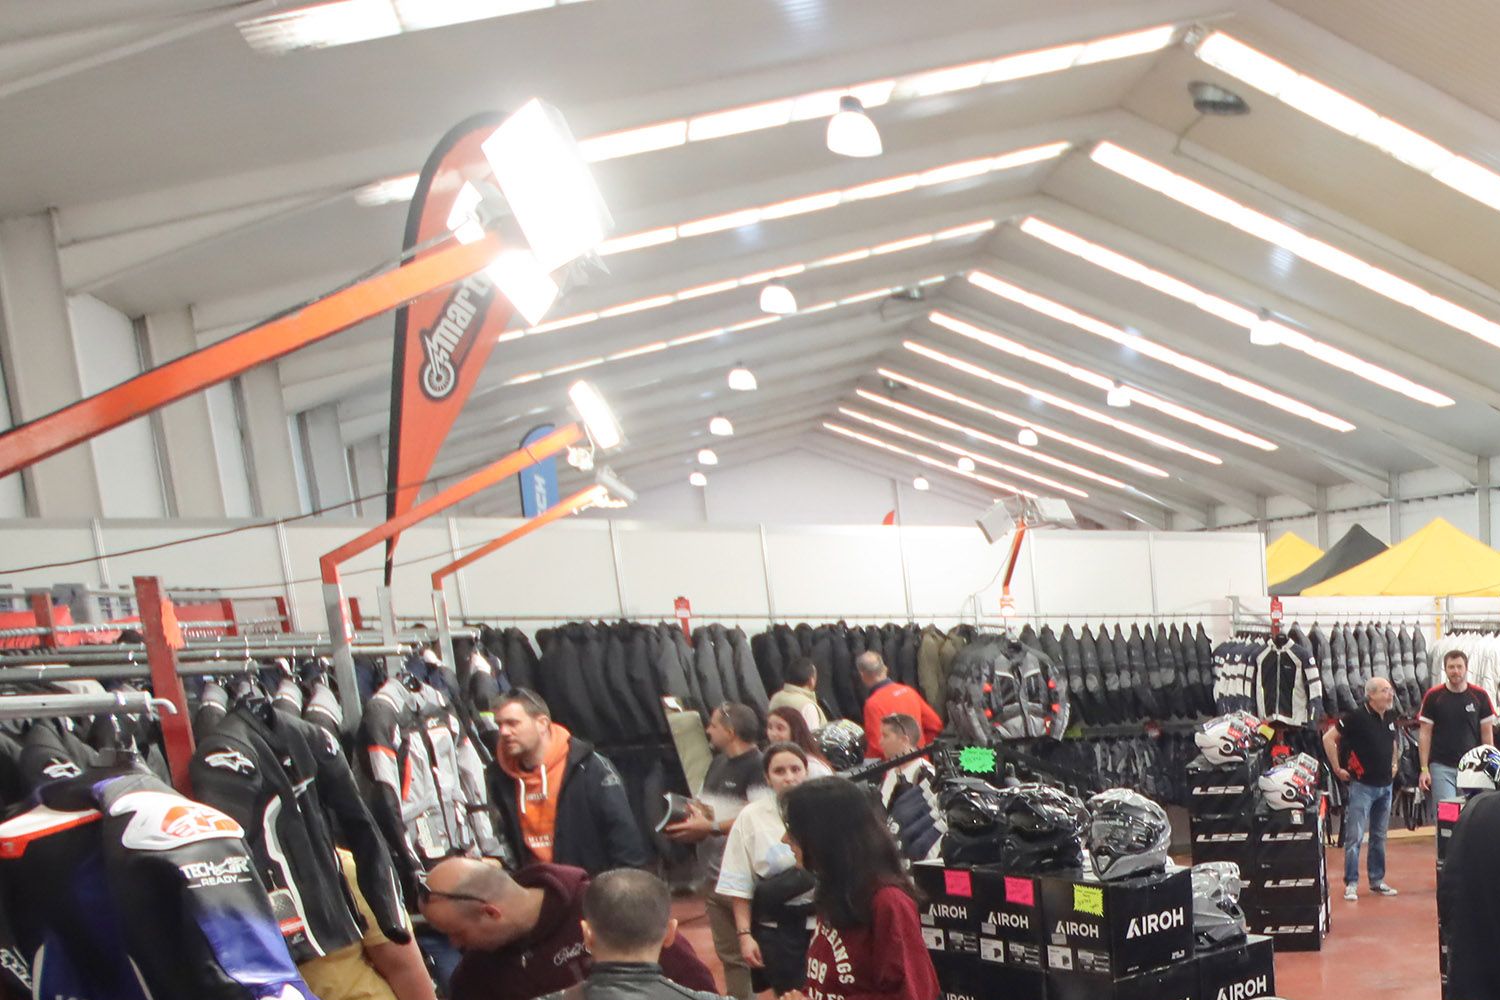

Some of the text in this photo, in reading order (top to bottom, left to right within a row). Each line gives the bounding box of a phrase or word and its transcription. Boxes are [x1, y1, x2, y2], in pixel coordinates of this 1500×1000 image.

[1192, 785, 1245, 796] LS2
[1195, 833, 1249, 843] LS2
[1261, 832, 1314, 842] LS2
[200, 874, 238, 887] READY
[1264, 878, 1315, 889] LS2
[928, 903, 968, 920] AIROH
[987, 910, 1029, 930] AIROH
[1126, 906, 1185, 940] AIROH
[1055, 920, 1099, 939] AIROH
[1263, 925, 1315, 935] LS2
